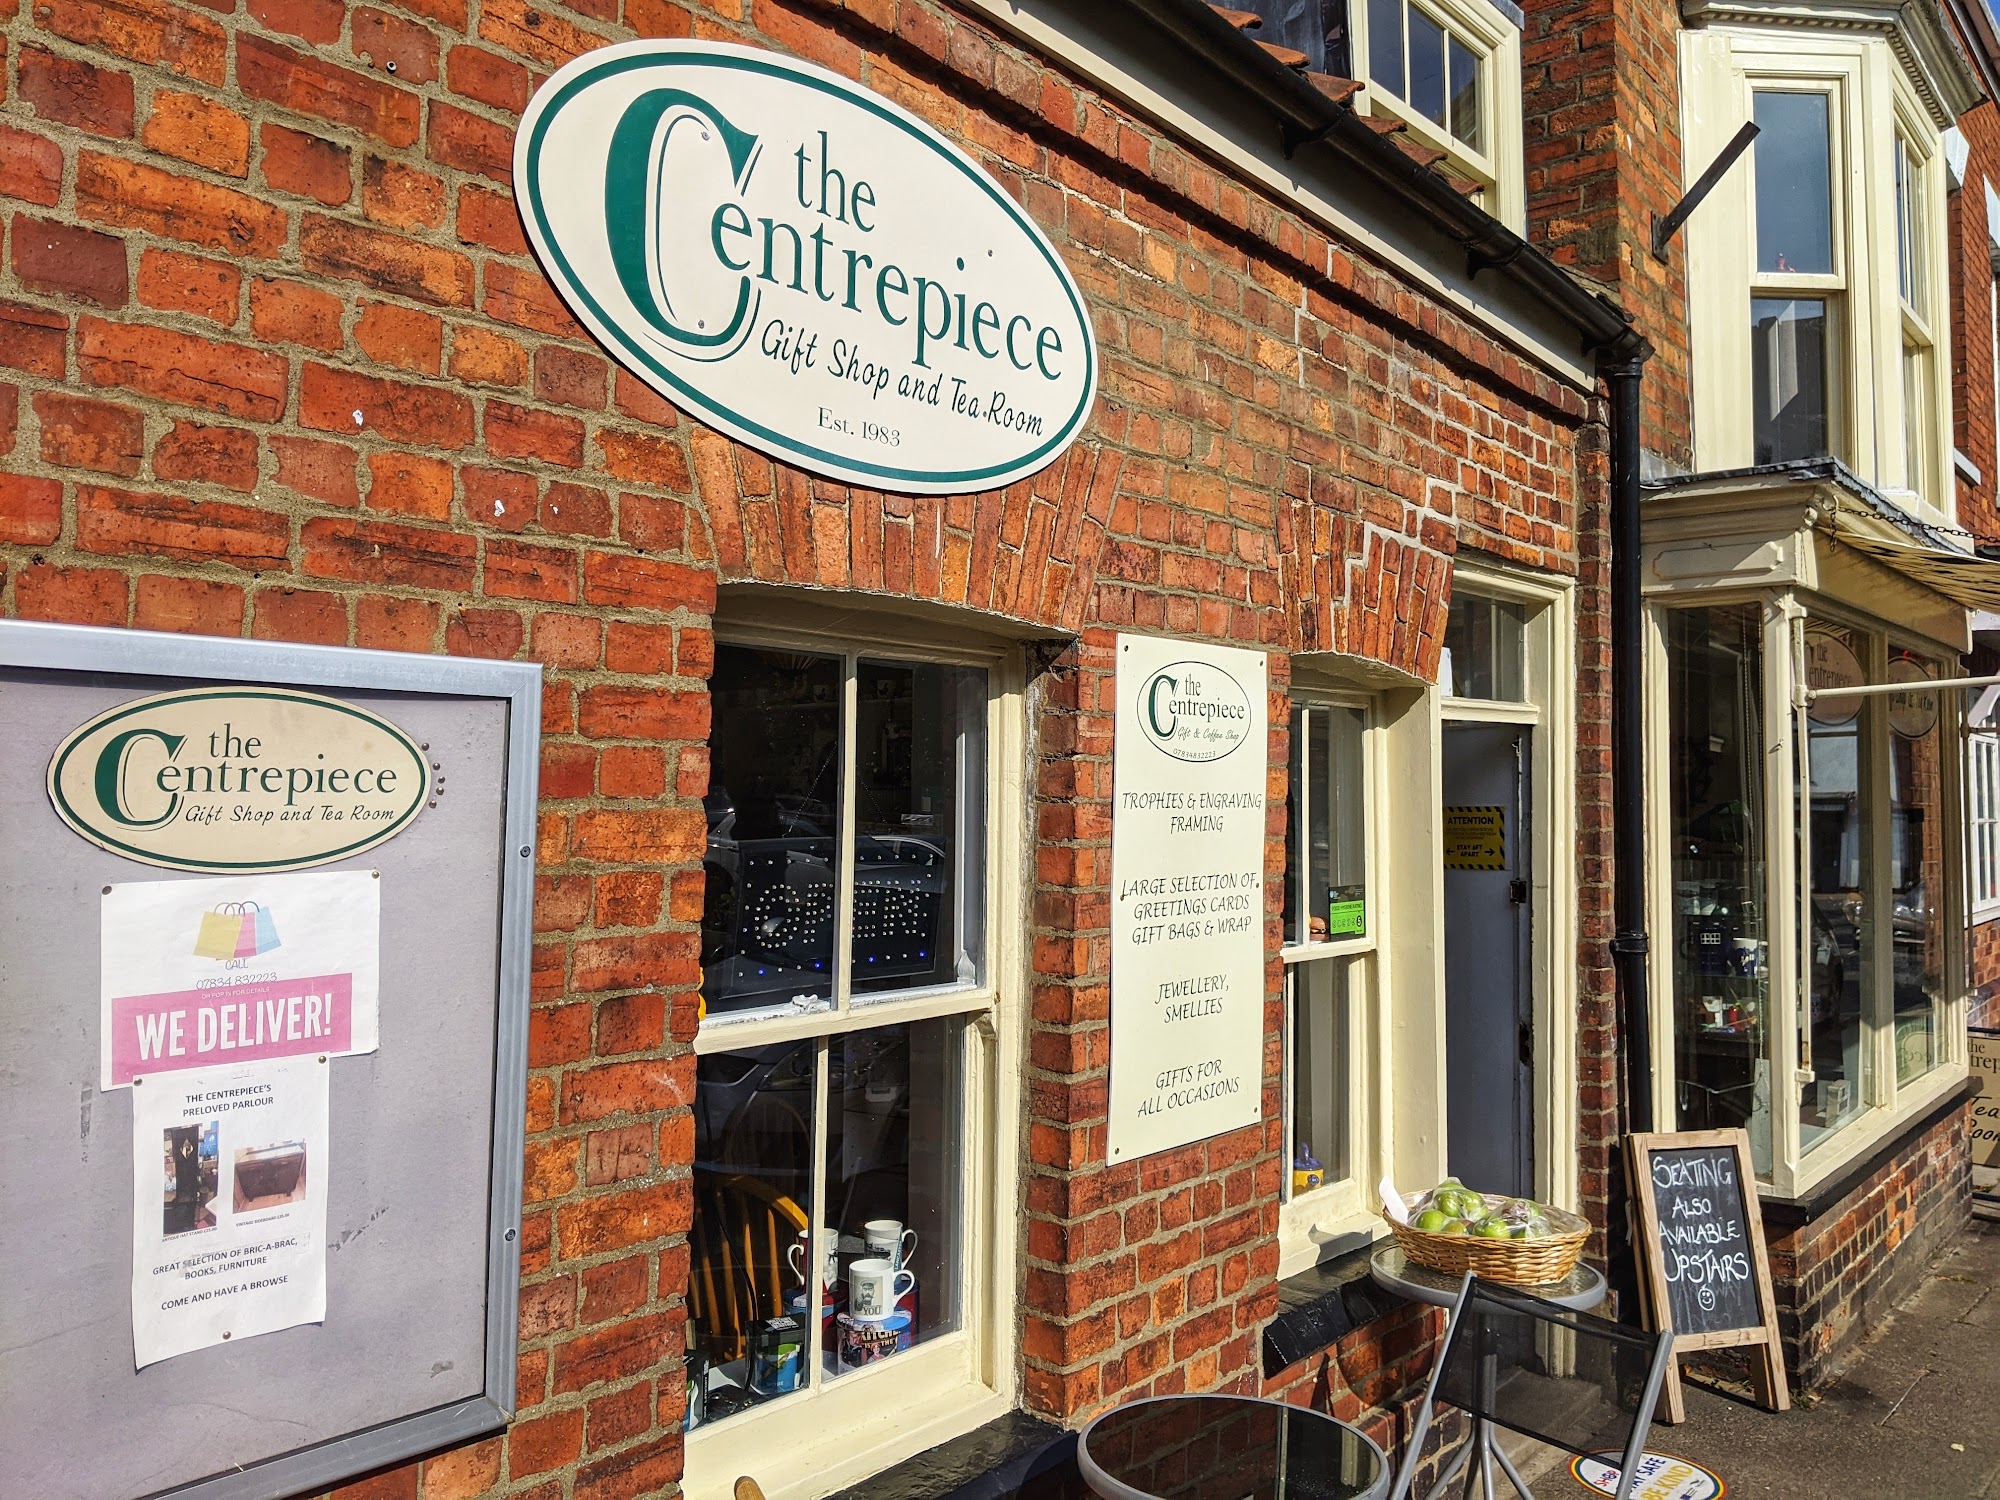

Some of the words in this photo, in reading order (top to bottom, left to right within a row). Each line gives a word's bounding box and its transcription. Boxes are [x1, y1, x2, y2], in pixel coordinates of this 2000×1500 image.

[794, 130, 876, 233] the
[604, 87, 1064, 381] Centrepiece
[760, 318, 818, 377] Gift
[826, 338, 889, 399] Shop
[897, 373, 943, 407] and
[817, 405, 855, 438] Est.
[861, 419, 901, 448] 1983
[1185, 673, 1201, 696] the
[1148, 674, 1245, 741] Centrepiece
[209, 723, 262, 759] the
[1177, 725, 1191, 740] Gift
[1193, 728, 1201, 739] &
[1203, 729, 1223, 743] Coffee
[1225, 729, 1239, 743] Shop
[94, 728, 397, 832] Centrepiece
[1122, 791, 1184, 809] TROPHIES
[1187, 792, 1196, 809] &
[1199, 791, 1262, 810] ENGRAVING
[185, 803, 223, 826] Gift
[230, 804, 273, 827] Shop
[280, 805, 314, 822] and
[321, 805, 346, 822] Tea
[350, 805, 395, 822] Room
[1170, 815, 1224, 834] FRAMING
[1447, 816, 1494, 825] ATTENTION
[1121, 877, 1167, 898] LARGE
[1169, 872, 1238, 895] SELECTION
[1133, 897, 1207, 921] GREETINGS
[1210, 894, 1250, 912] CARDS
[1131, 925, 1165, 945] GIFT
[1168, 920, 1201, 941] BAGS
[1204, 919, 1214, 936] &
[1217, 915, 1252, 934] WRAP
[225, 959, 249, 971] CALL
[196, 977, 231, 990] 07834
[235, 972, 278, 986] 832223
[1155, 974, 1229, 1005] JEWELLERY,
[1163, 997, 1223, 1024] SMELLIES
[136, 1009, 186, 1061] WE
[197, 992, 332, 1053] DELIVER!
[1155, 1065, 1193, 1090] GIFTS
[1196, 1059, 1222, 1078] FOR
[182, 1102, 230, 1117] PRELOVED
[232, 1097, 274, 1111] PARLOUR
[185, 1094, 203, 1104] THE
[205, 1084, 272, 1102] CENTREPIECE'S
[1137, 1096, 1163, 1118] ALL
[1167, 1076, 1240, 1110] OCCASIONS
[1652, 1153, 1733, 1189] SEATING
[1671, 1196, 1712, 1219] ALSO
[1658, 1219, 1741, 1245] AVAILABLE
[152, 1261, 180, 1276] GREAT
[182, 1251, 227, 1268] SELECTION
[229, 1248, 241, 1258] OF
[244, 1238, 298, 1256] BRIC-A-BRAC,
[185, 1266, 216, 1280] BOOKS,
[218, 1255, 267, 1273] FURNITURE
[1662, 1248, 1750, 1283] UPSTAIRS
[161, 1295, 189, 1311] COME
[191, 1291, 212, 1304] AND
[214, 1285, 239, 1298] HAVE
[241, 1282, 248, 1292] A
[250, 1275, 288, 1290] BROWSE
[863, 1304, 882, 1316] YOU
[1637, 1457, 1667, 1476] SAFE
[1654, 1465, 1694, 1489] KIND
